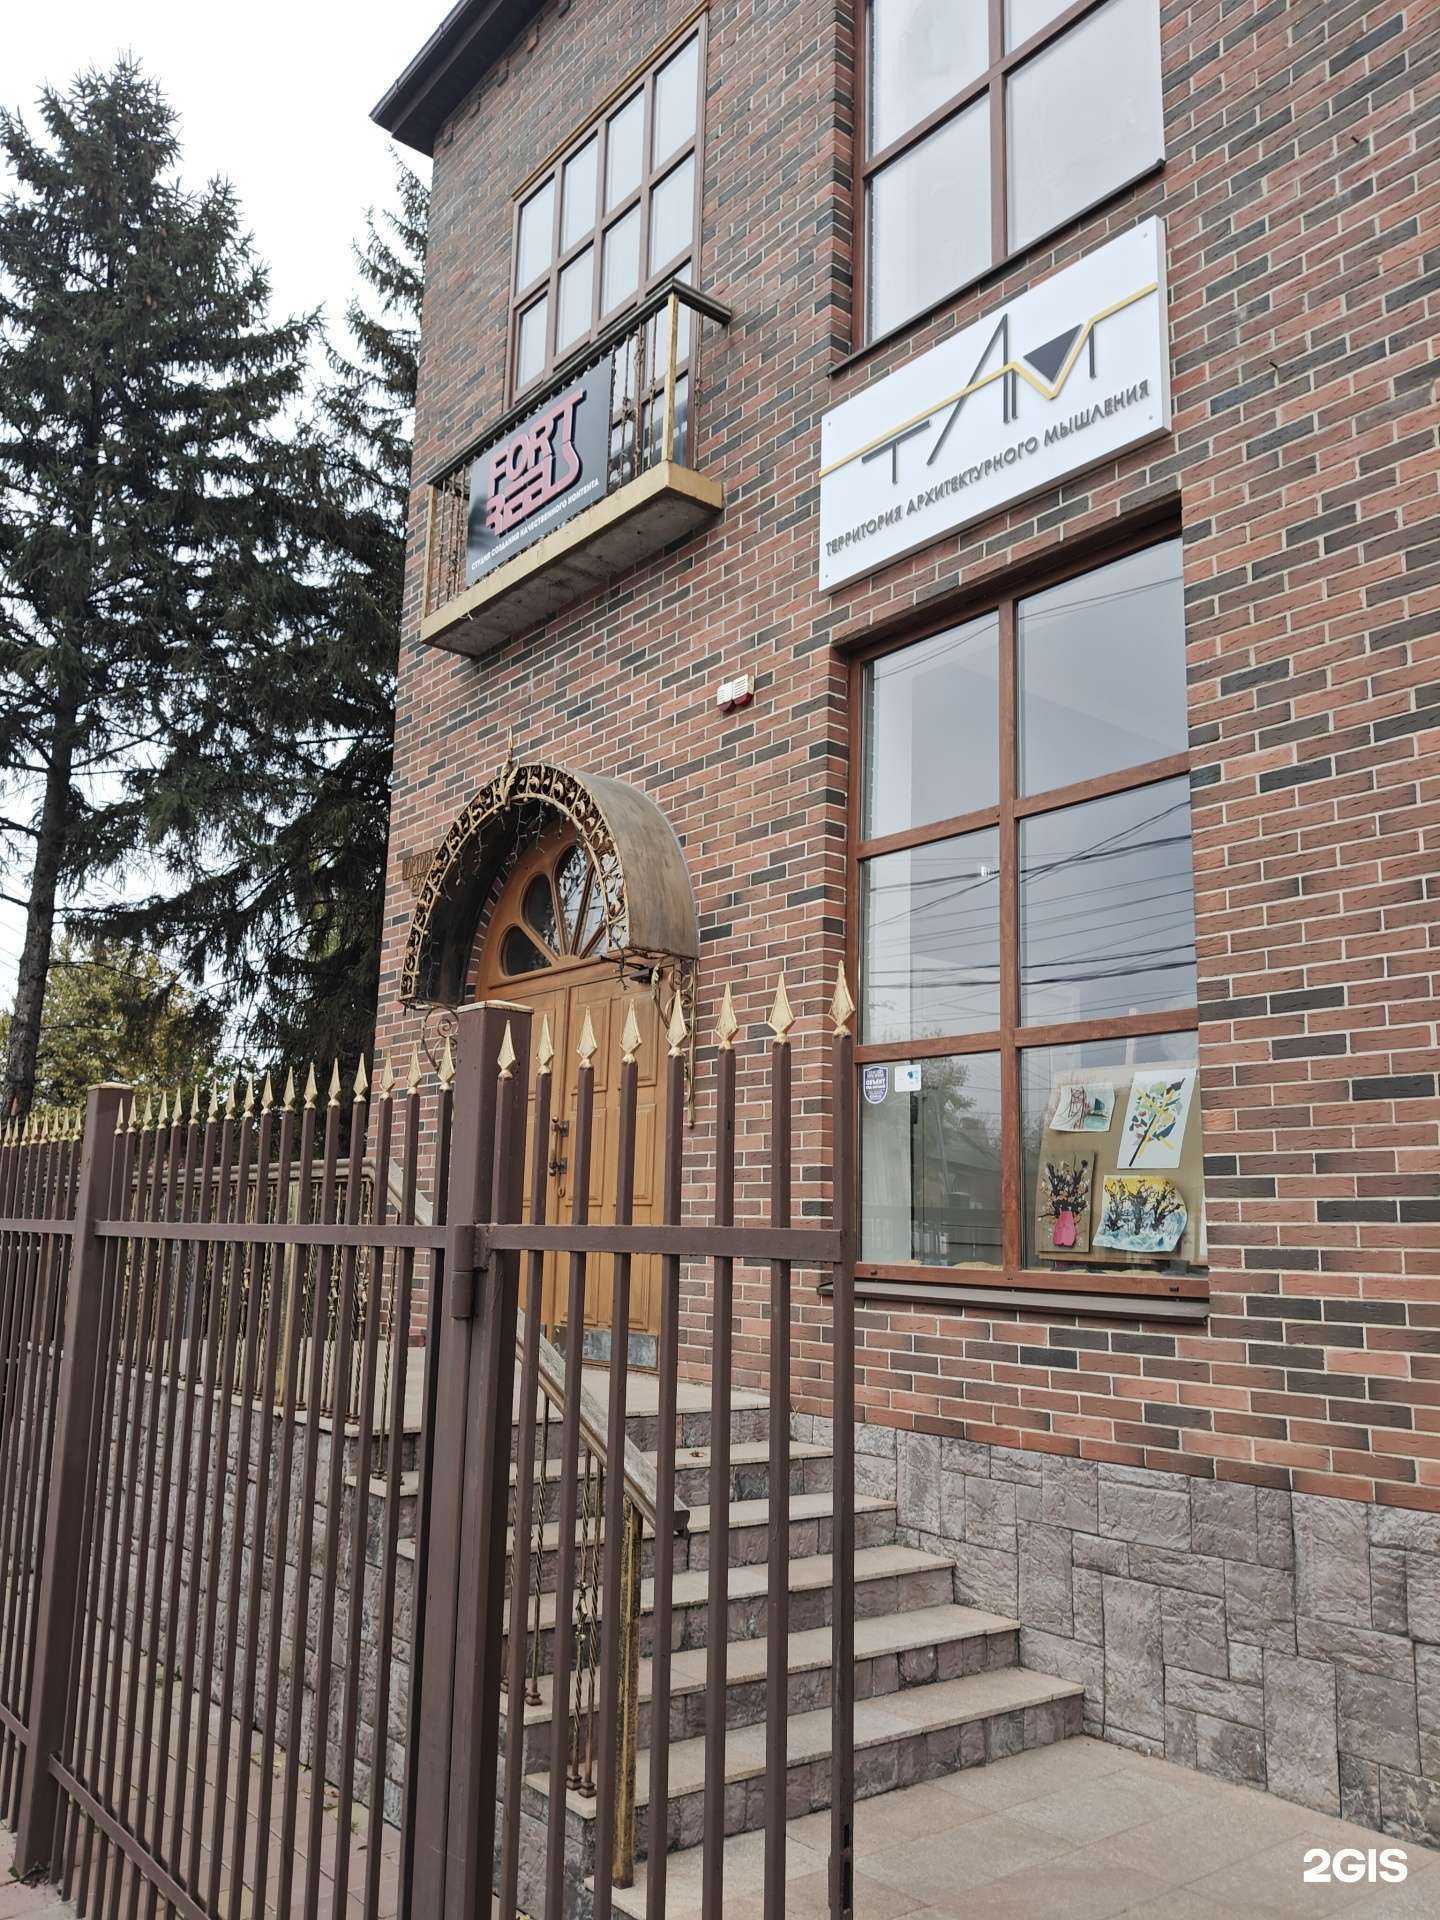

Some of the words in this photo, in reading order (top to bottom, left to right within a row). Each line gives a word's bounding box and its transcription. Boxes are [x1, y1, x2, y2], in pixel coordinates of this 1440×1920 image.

[489, 389, 584, 497] FORT
[825, 505, 902, 557] ТЕРРИТОРИЯ
[906, 435, 1038, 516] АРХИТЕКТУРНОГО
[1044, 379, 1150, 447] МЫШЛЕНИЯ
[861, 312, 1097, 485] ТАМ
[520, 499, 567, 537] КАЧЕСТВЕННОГО
